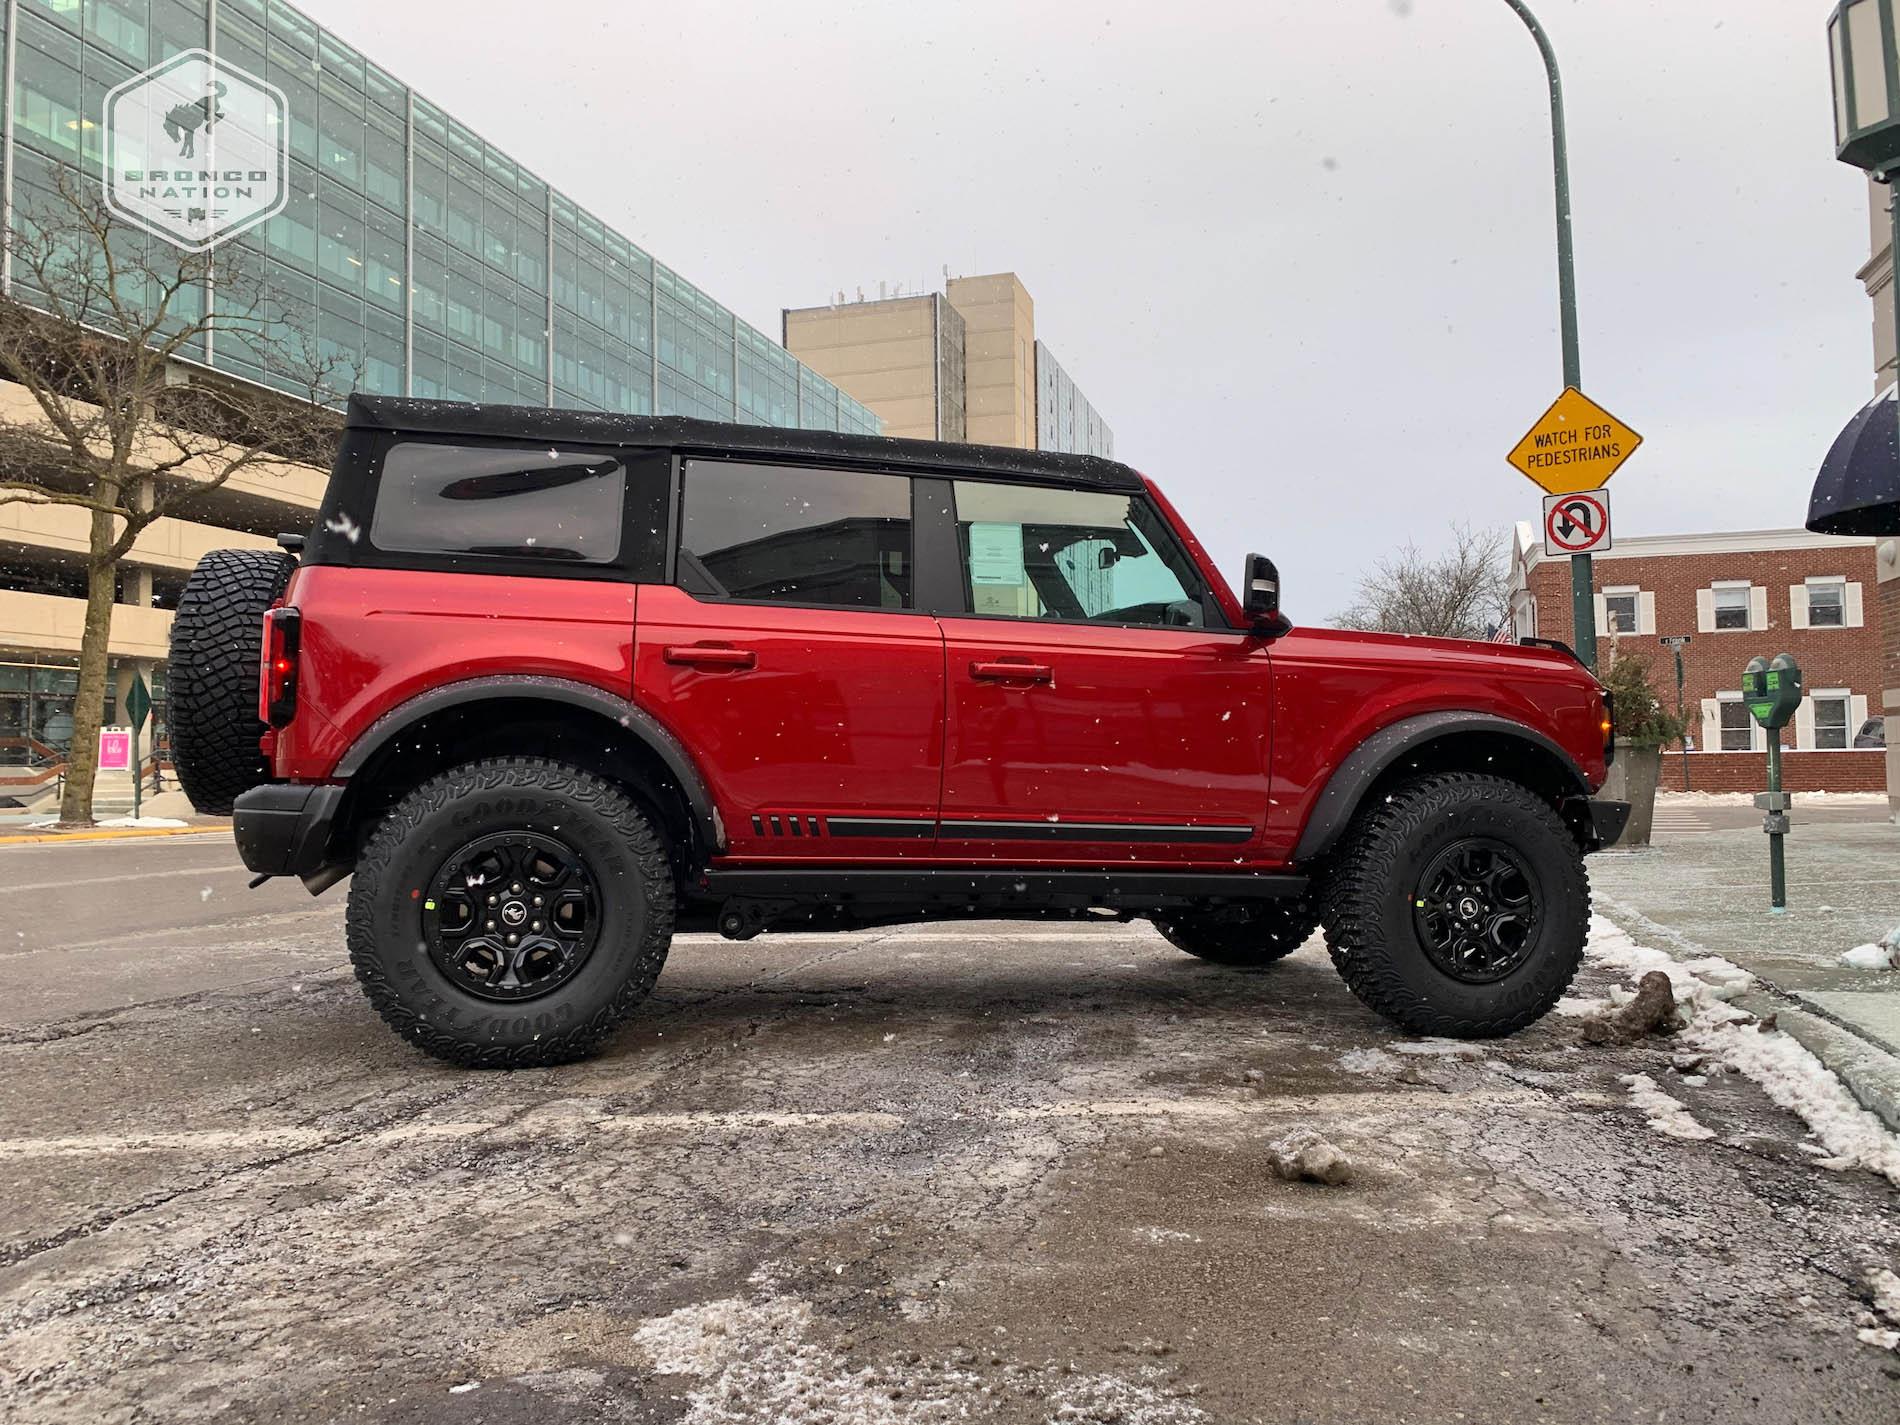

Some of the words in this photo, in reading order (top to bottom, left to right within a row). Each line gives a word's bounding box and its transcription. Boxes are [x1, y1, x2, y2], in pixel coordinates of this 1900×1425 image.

[1534, 429, 1577, 448] WATCH
[1585, 424, 1611, 441] FOR
[1527, 443, 1620, 469] PEDESTRIANS
